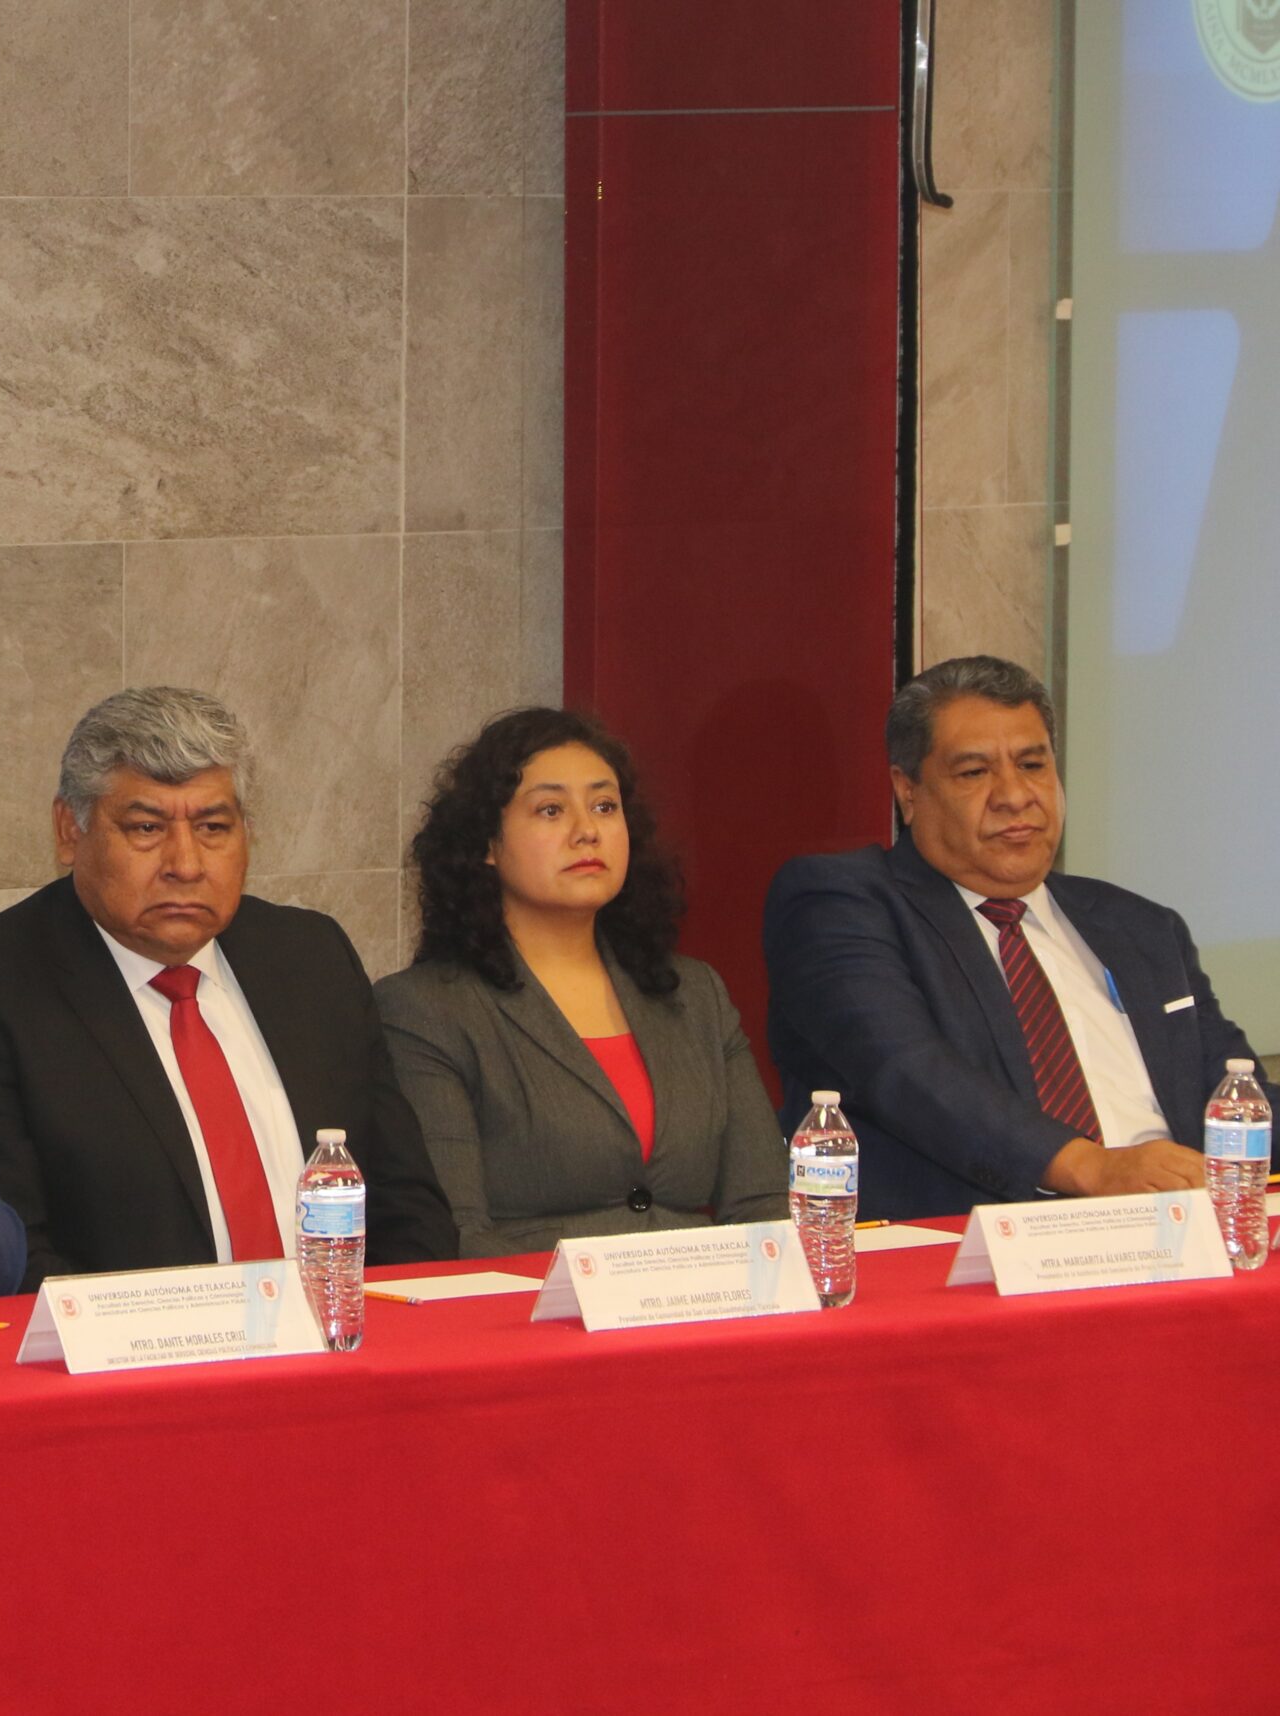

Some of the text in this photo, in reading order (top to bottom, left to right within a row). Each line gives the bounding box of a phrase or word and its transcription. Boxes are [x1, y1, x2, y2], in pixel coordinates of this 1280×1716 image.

[604, 1249, 653, 1261] UNIVERSIDAD
[701, 1244, 710, 1252] DE
[712, 1241, 750, 1251] TLAXCALA
[88, 1290, 141, 1302] UNIVERSIDAD
[193, 1284, 204, 1293] DE
[206, 1281, 247, 1291] TLAXCALA
[666, 1295, 689, 1307] JAIME
[690, 1291, 722, 1305] AMADOR
[723, 1289, 752, 1302] FLORES
[157, 1335, 183, 1349] DANTE
[184, 1332, 224, 1346] MORALES
[225, 1330, 247, 1343] CRUZ
